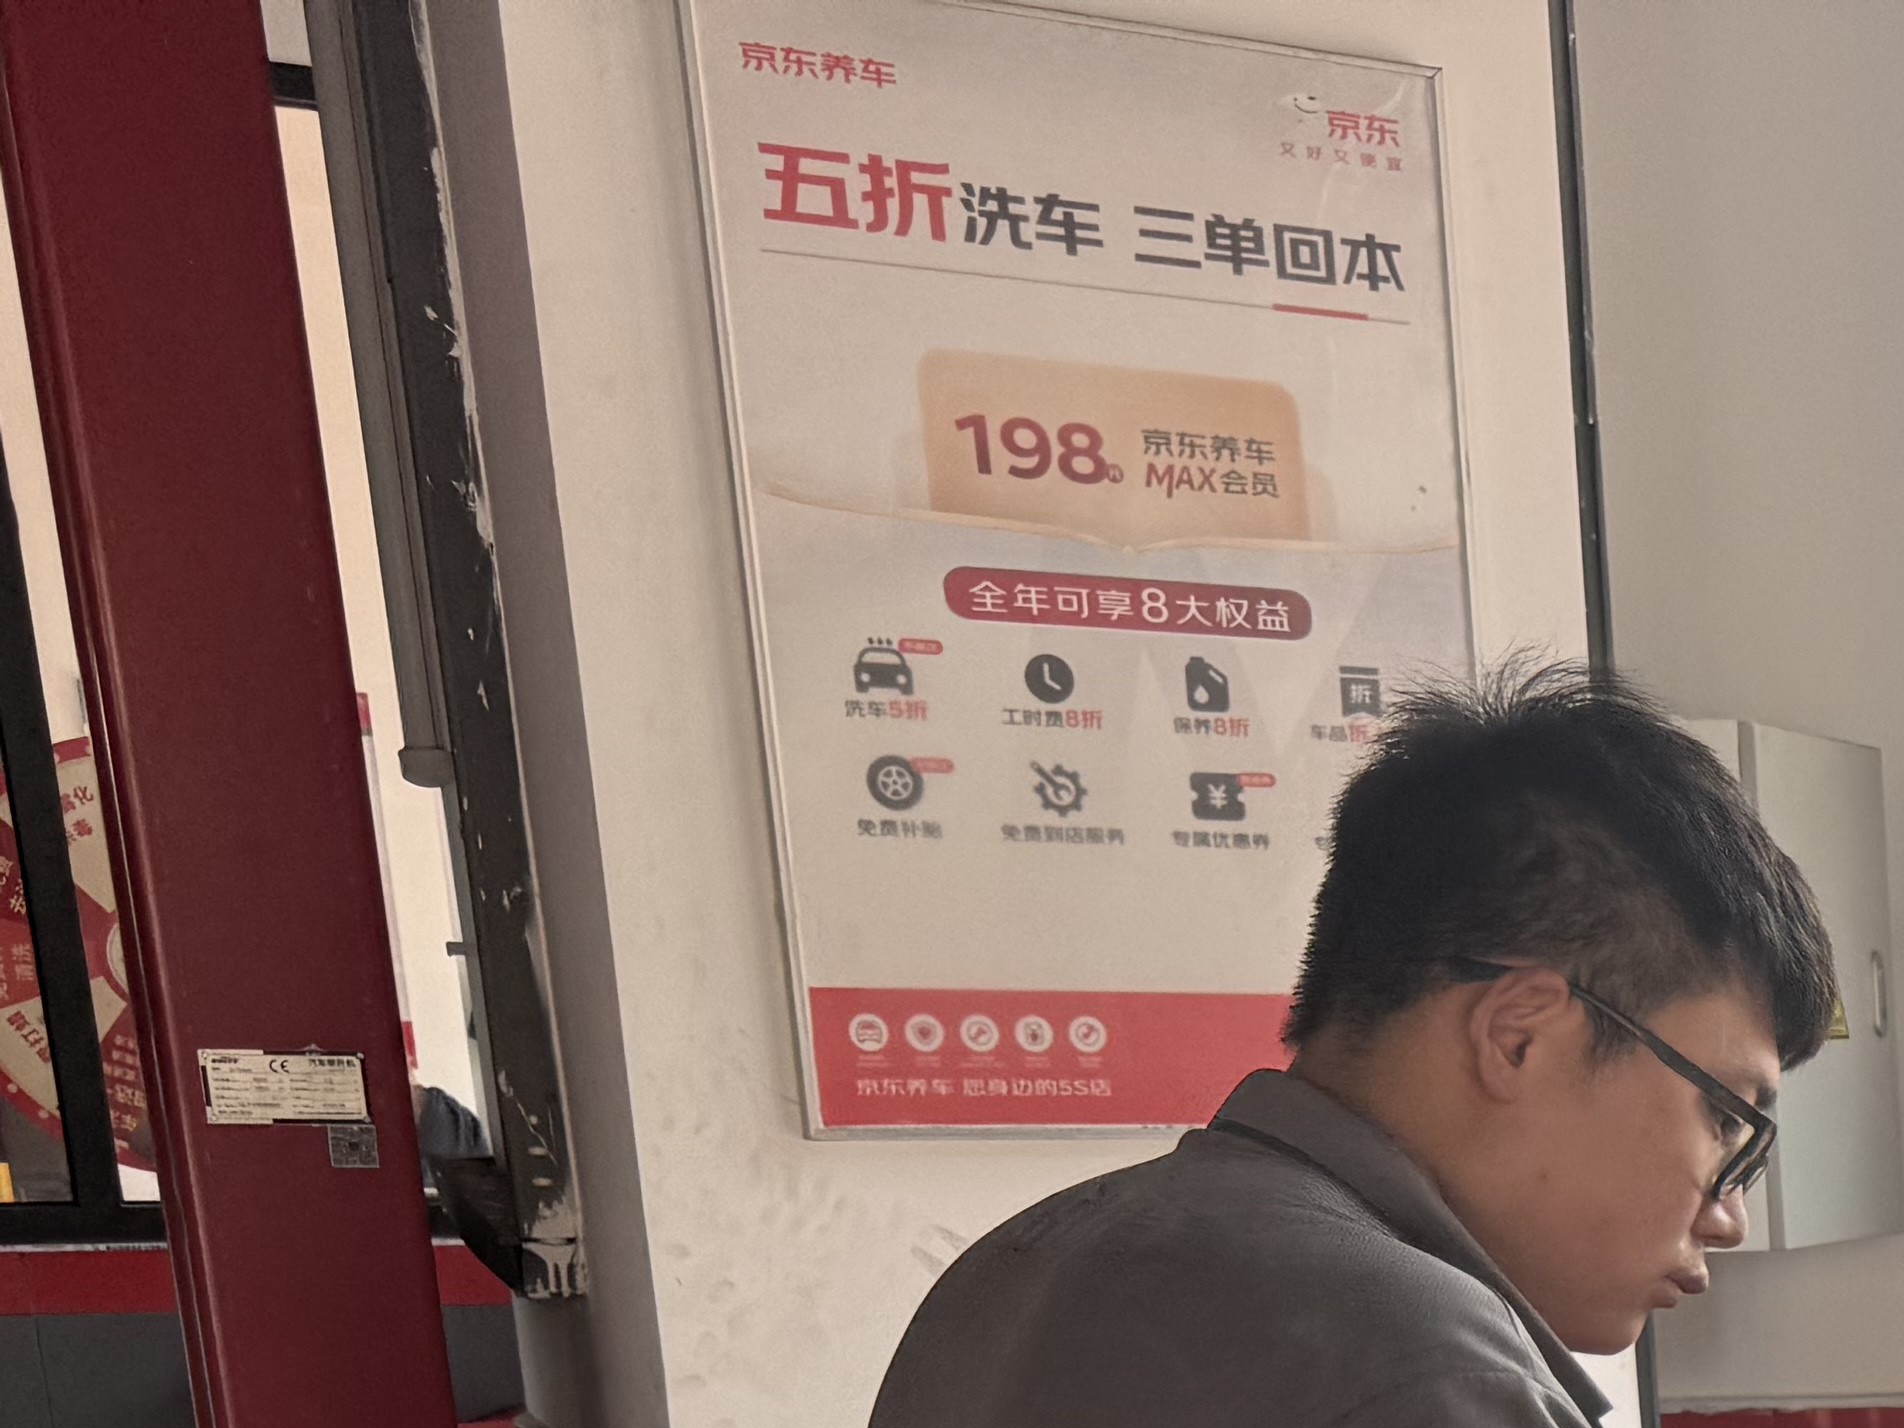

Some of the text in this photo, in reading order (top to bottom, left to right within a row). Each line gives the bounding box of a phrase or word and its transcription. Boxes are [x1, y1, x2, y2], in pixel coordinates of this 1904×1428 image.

[739, 41, 897, 89] 京东养车
[1326, 110, 1400, 148] 京东
[1279, 141, 1402, 172] 又好又便宜
[757, 141, 1406, 293] 五折洗车 三单回本
[1140, 428, 1276, 466] 京东养车
[1145, 461, 1281, 499] MAX会员
[969, 580, 1292, 634] 全年可享8大权益
[844, 699, 929, 722] 洗车5折
[1002, 707, 1103, 731] 工时费8折
[1173, 716, 1251, 739] 保养8折
[856, 1079, 1113, 1098] 京东养车 您身边的5S店
